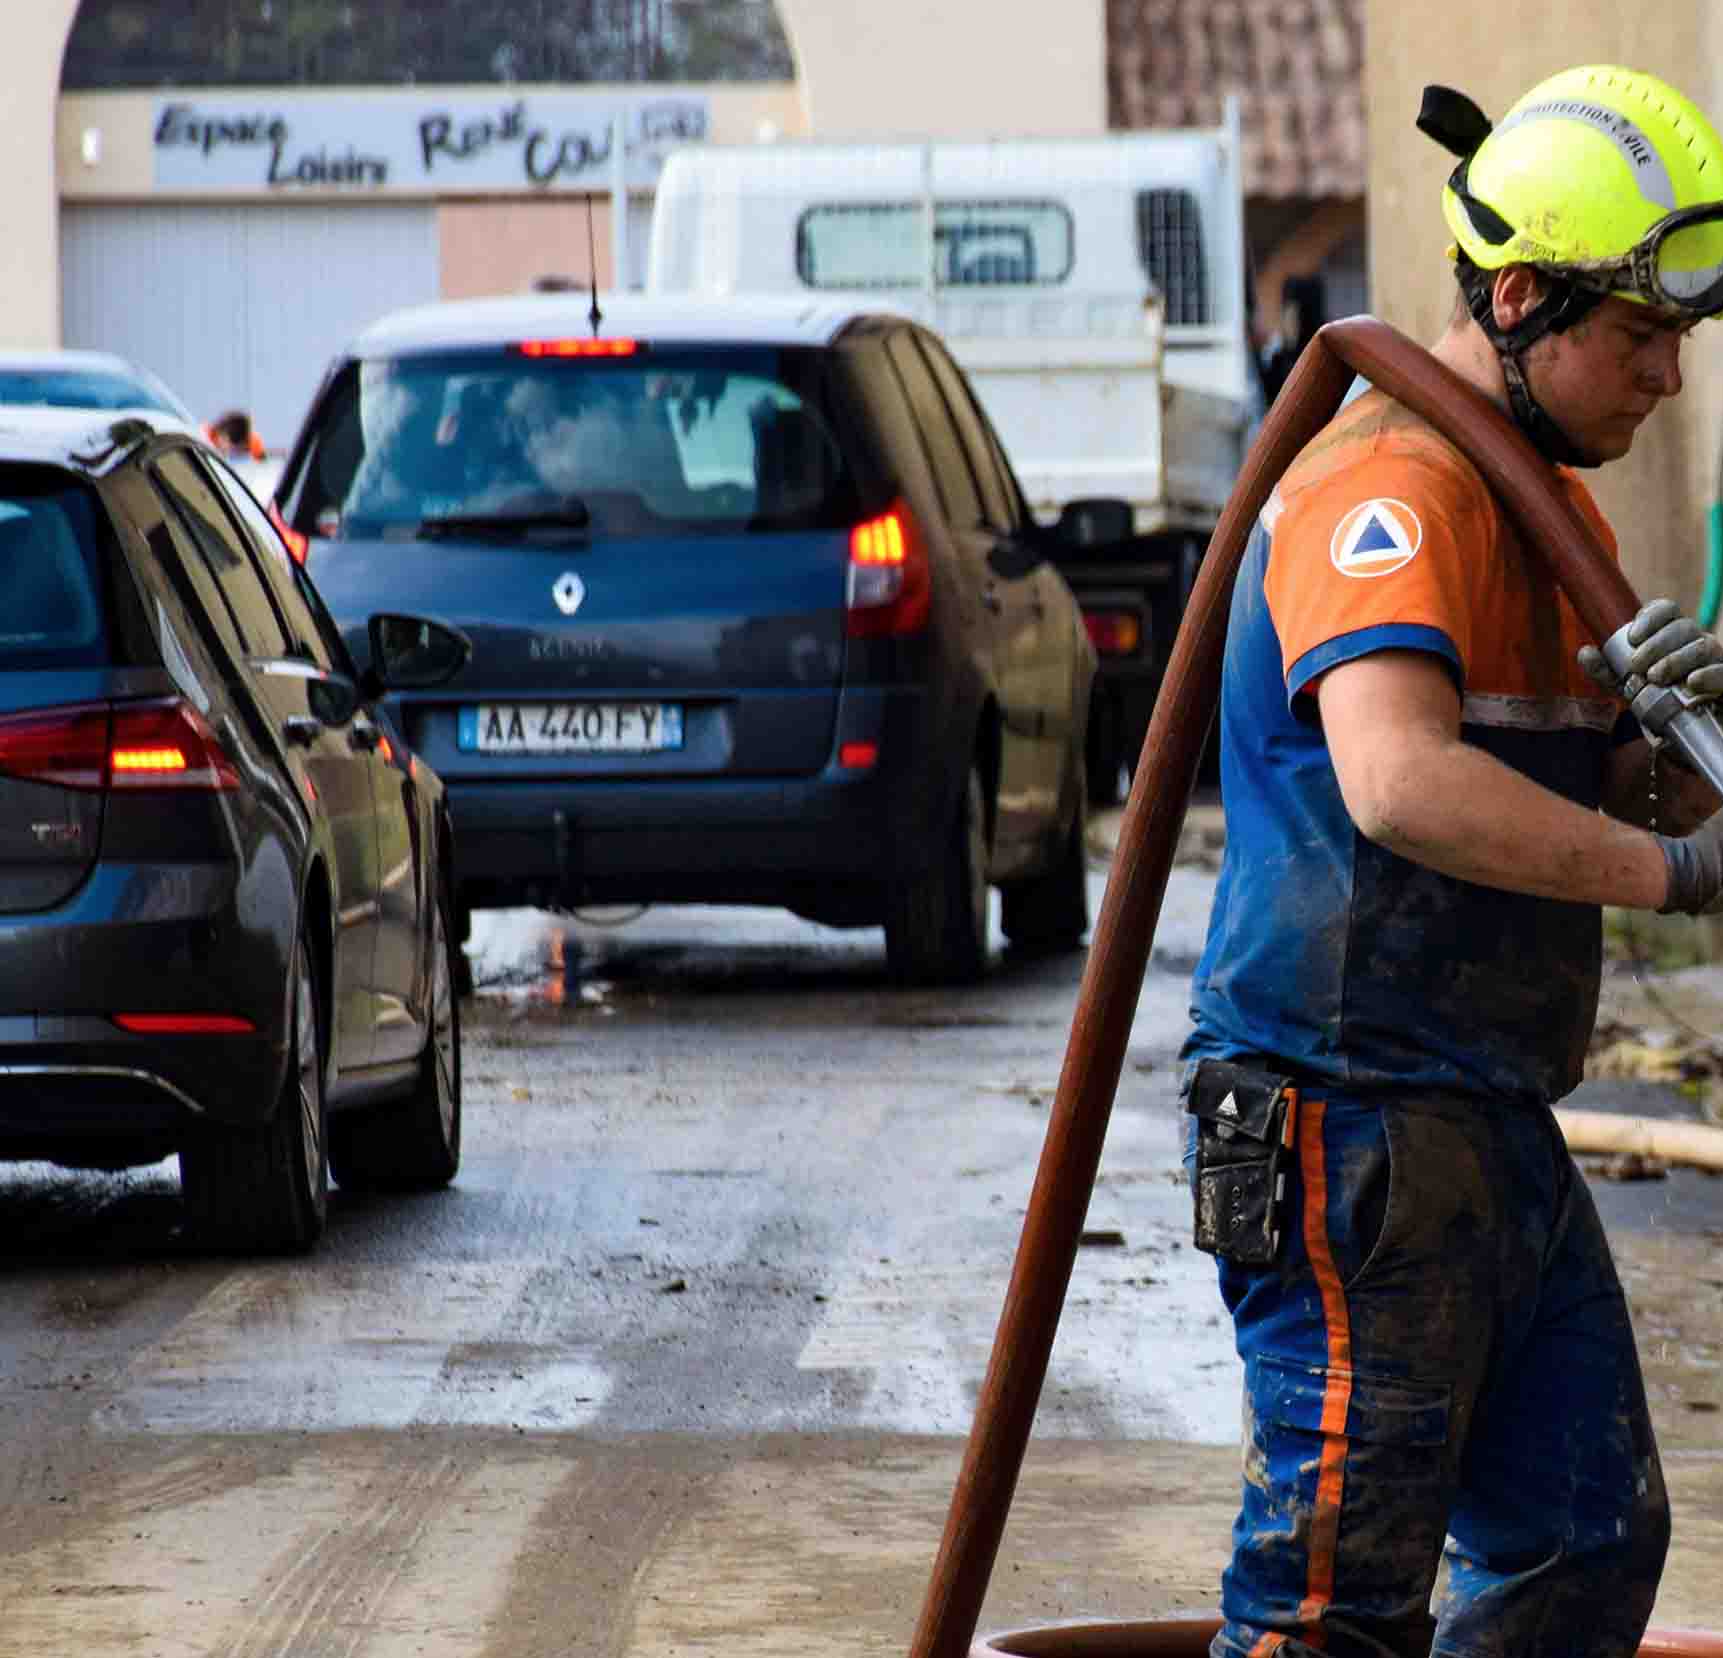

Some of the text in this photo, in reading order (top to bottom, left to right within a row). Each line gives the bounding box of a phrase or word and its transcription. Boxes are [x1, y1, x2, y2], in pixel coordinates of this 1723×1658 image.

[486, 705, 659, 743] AA 440 FY
